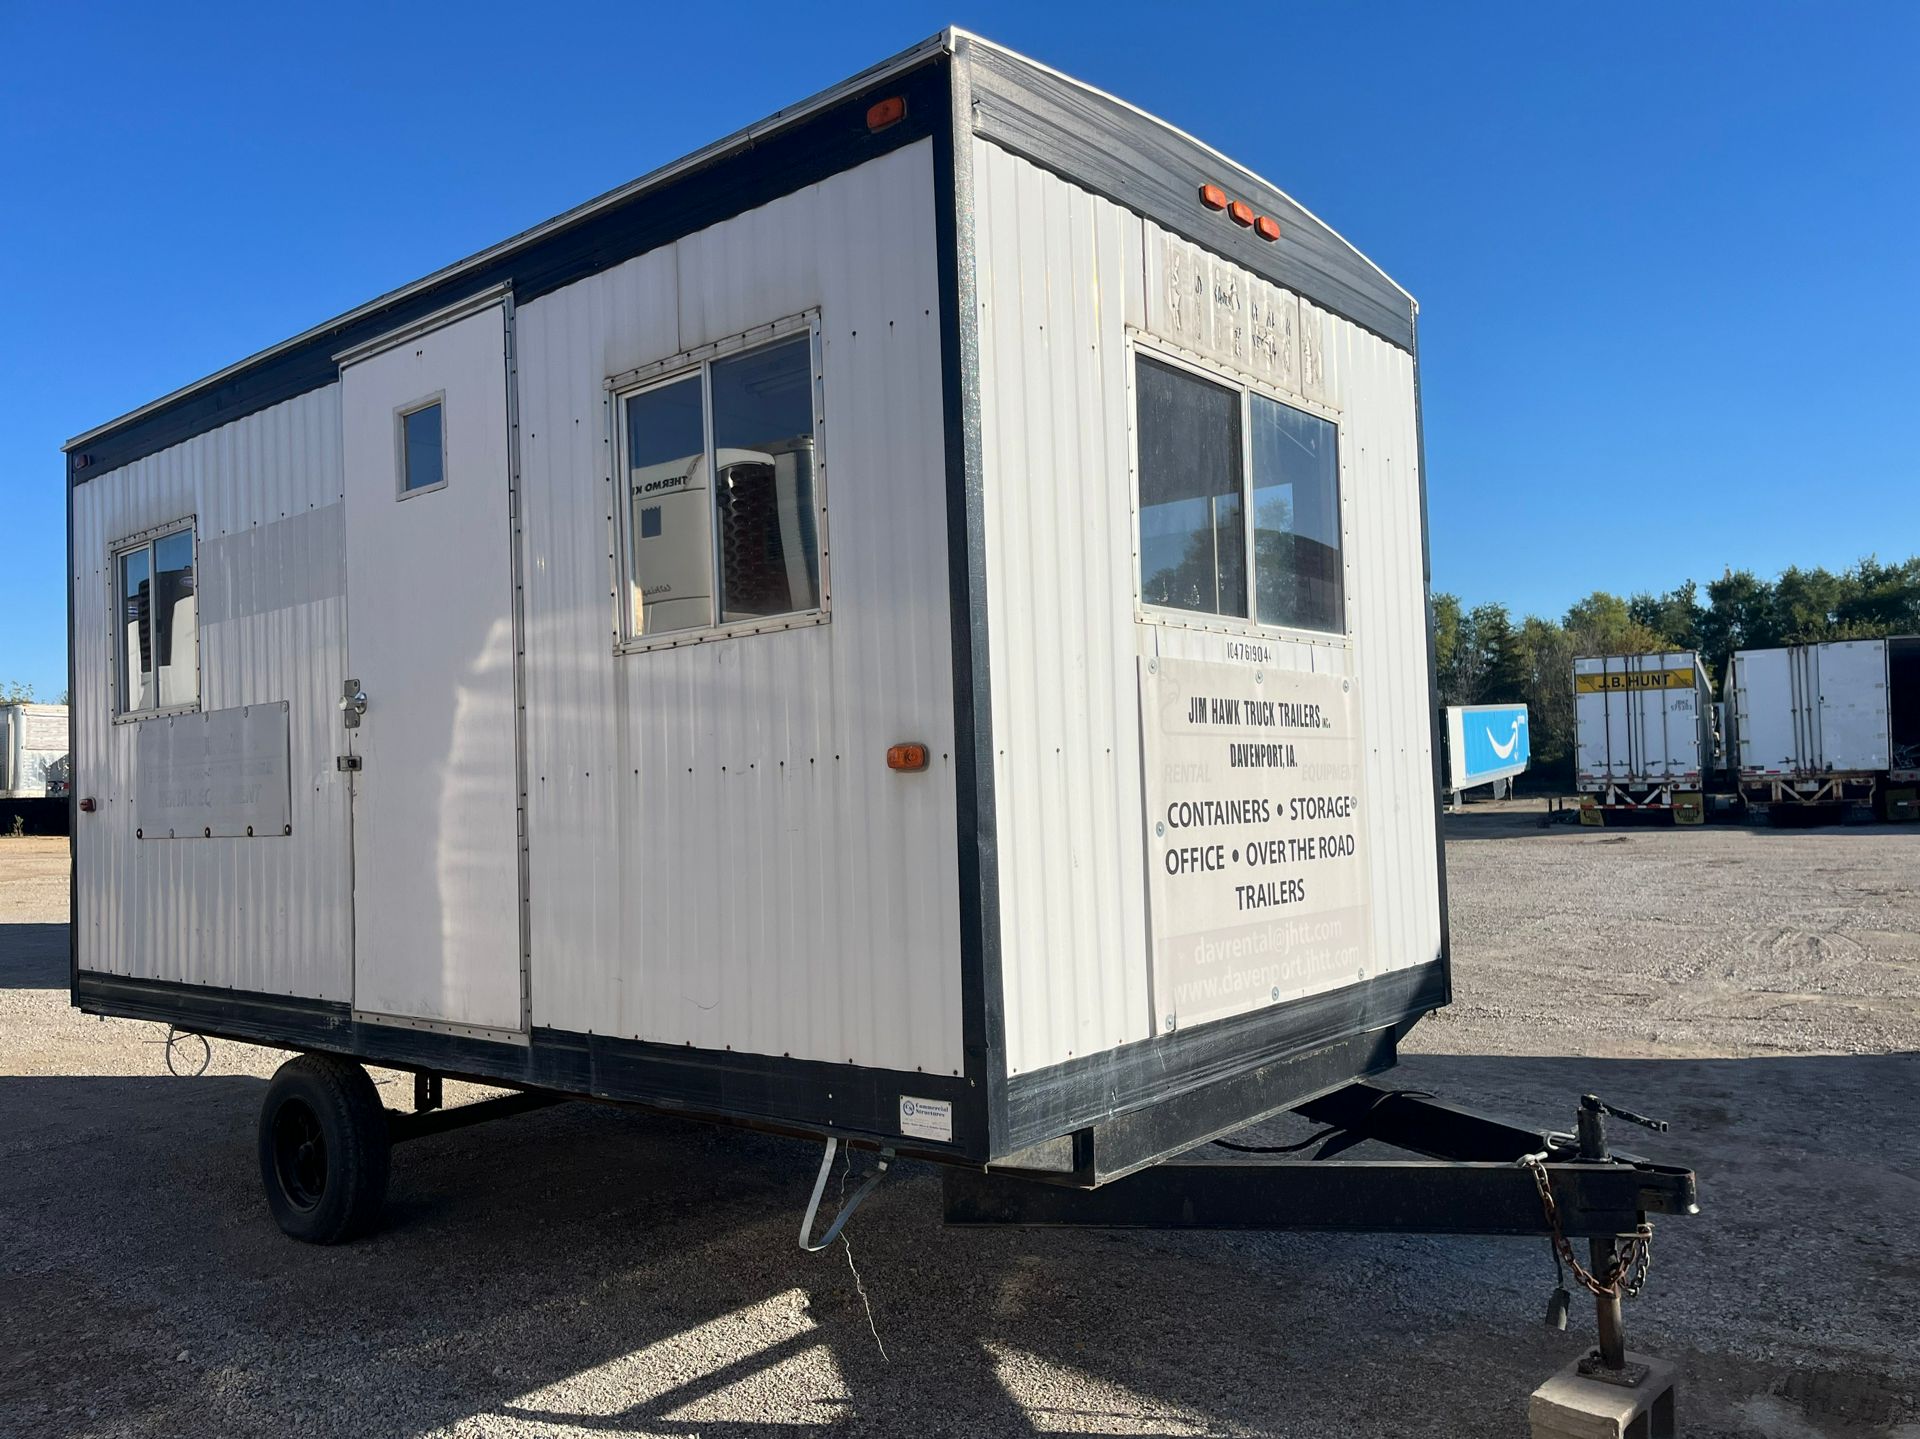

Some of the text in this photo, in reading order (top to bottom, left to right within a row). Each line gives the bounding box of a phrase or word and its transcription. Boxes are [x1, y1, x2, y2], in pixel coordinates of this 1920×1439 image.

[1628, 674, 1671, 687] HUNT
[1188, 696, 1207, 724] JIM
[1212, 698, 1241, 725] HAWK
[1243, 700, 1276, 727] TRUCK
[1278, 702, 1321, 729] TRAILERS
[1164, 763, 1359, 784] RENTAL EQUIPMENT
[1167, 795, 1351, 829] CONTAINERS STORAGE
[1165, 834, 1355, 875] OFFICE OVER THE ROAD
[1235, 878, 1305, 911] TRAILERS
[1194, 918, 1343, 966] davrental@jhtt.com
